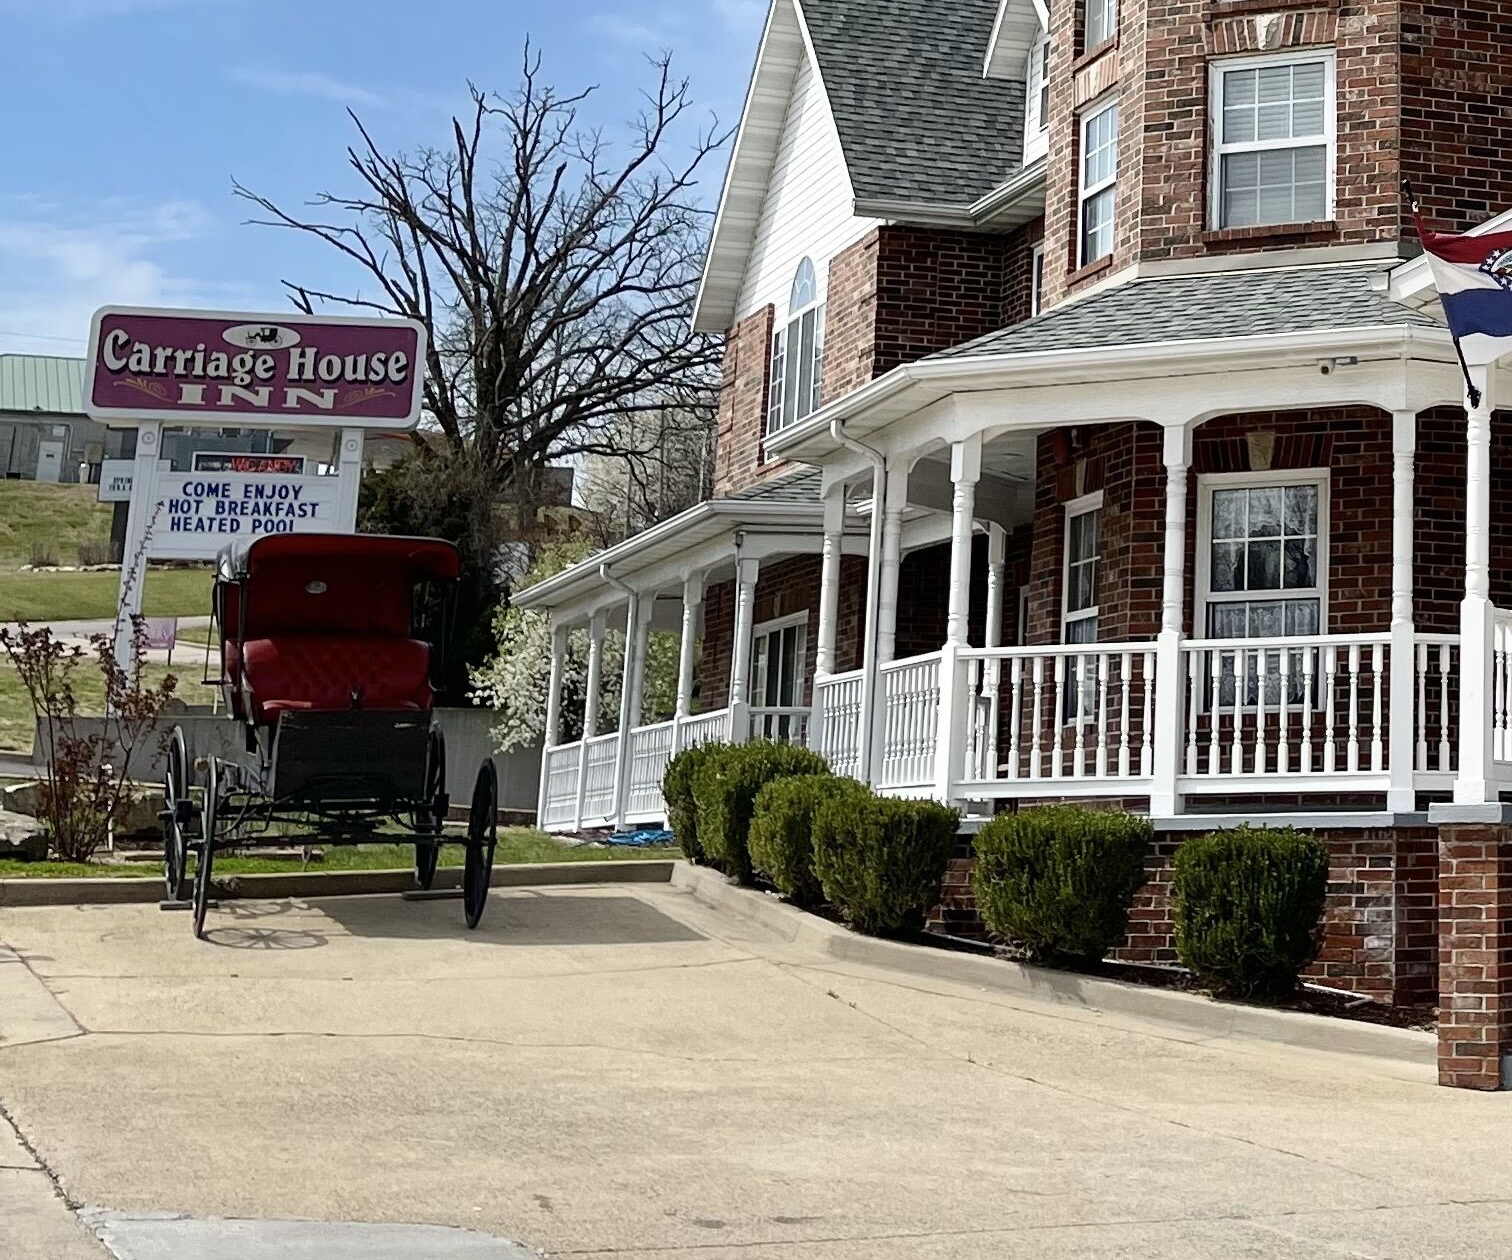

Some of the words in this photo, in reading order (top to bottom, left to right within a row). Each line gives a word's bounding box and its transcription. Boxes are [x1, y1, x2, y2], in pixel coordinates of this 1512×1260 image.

[102, 328, 276, 385] Carriage
[286, 347, 408, 382] House
[177, 383, 339, 409] INN
[182, 482, 231, 498] COME
[243, 484, 303, 500] ENJOY
[168, 499, 204, 515] HOT
[215, 501, 319, 518] BREAKFAST
[170, 517, 241, 533] HEATED
